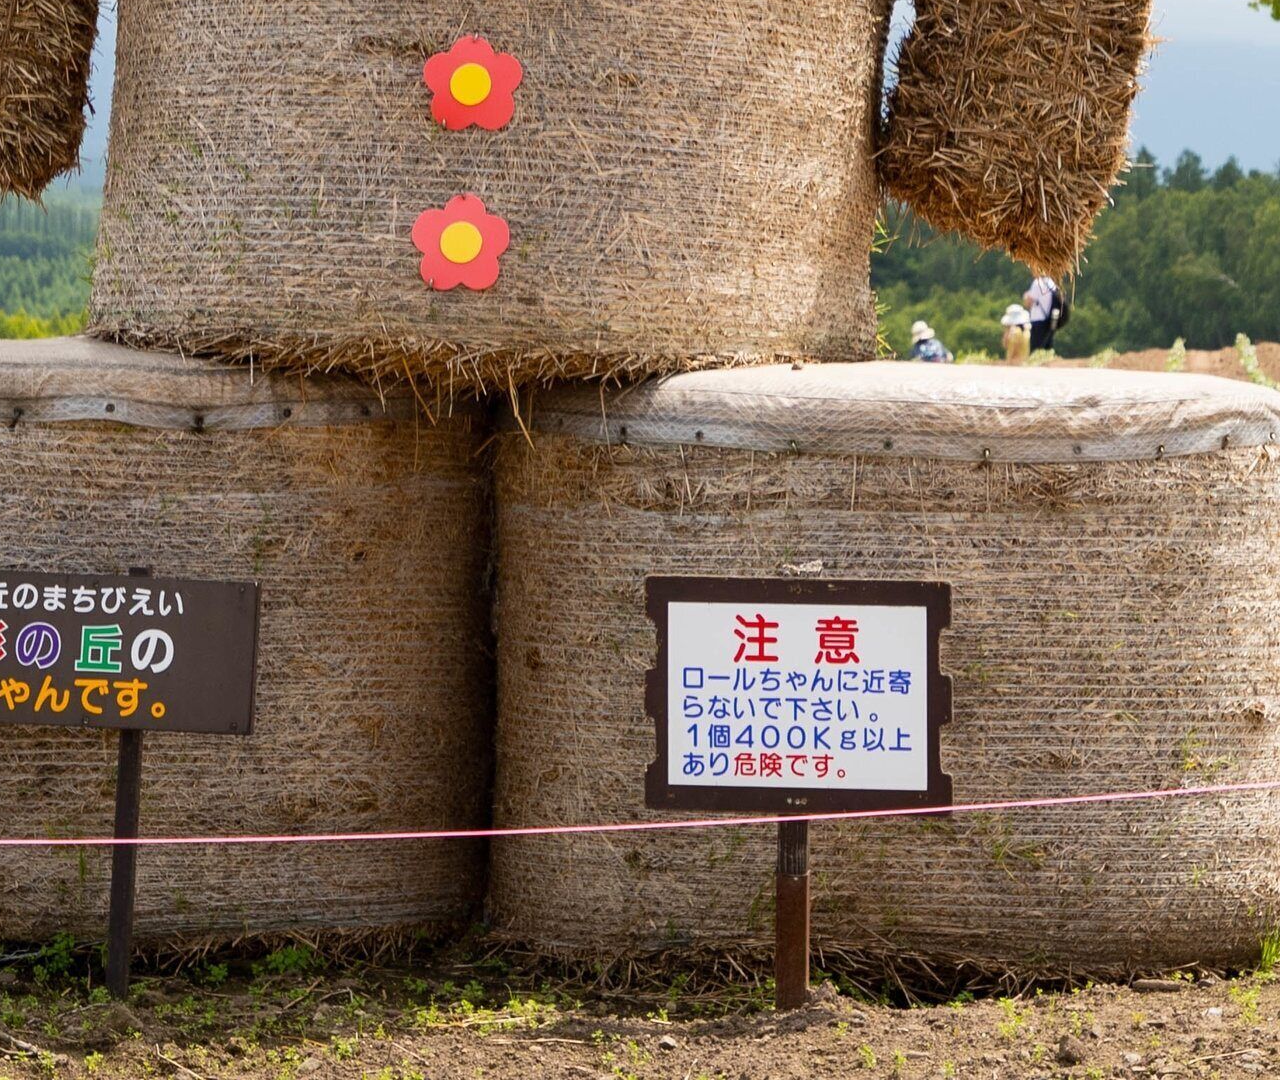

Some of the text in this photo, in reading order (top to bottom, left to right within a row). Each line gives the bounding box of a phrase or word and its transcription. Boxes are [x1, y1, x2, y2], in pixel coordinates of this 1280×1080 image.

[733, 613, 861, 665] 注意
[682, 666, 912, 695] ロールちゃんに近寄
